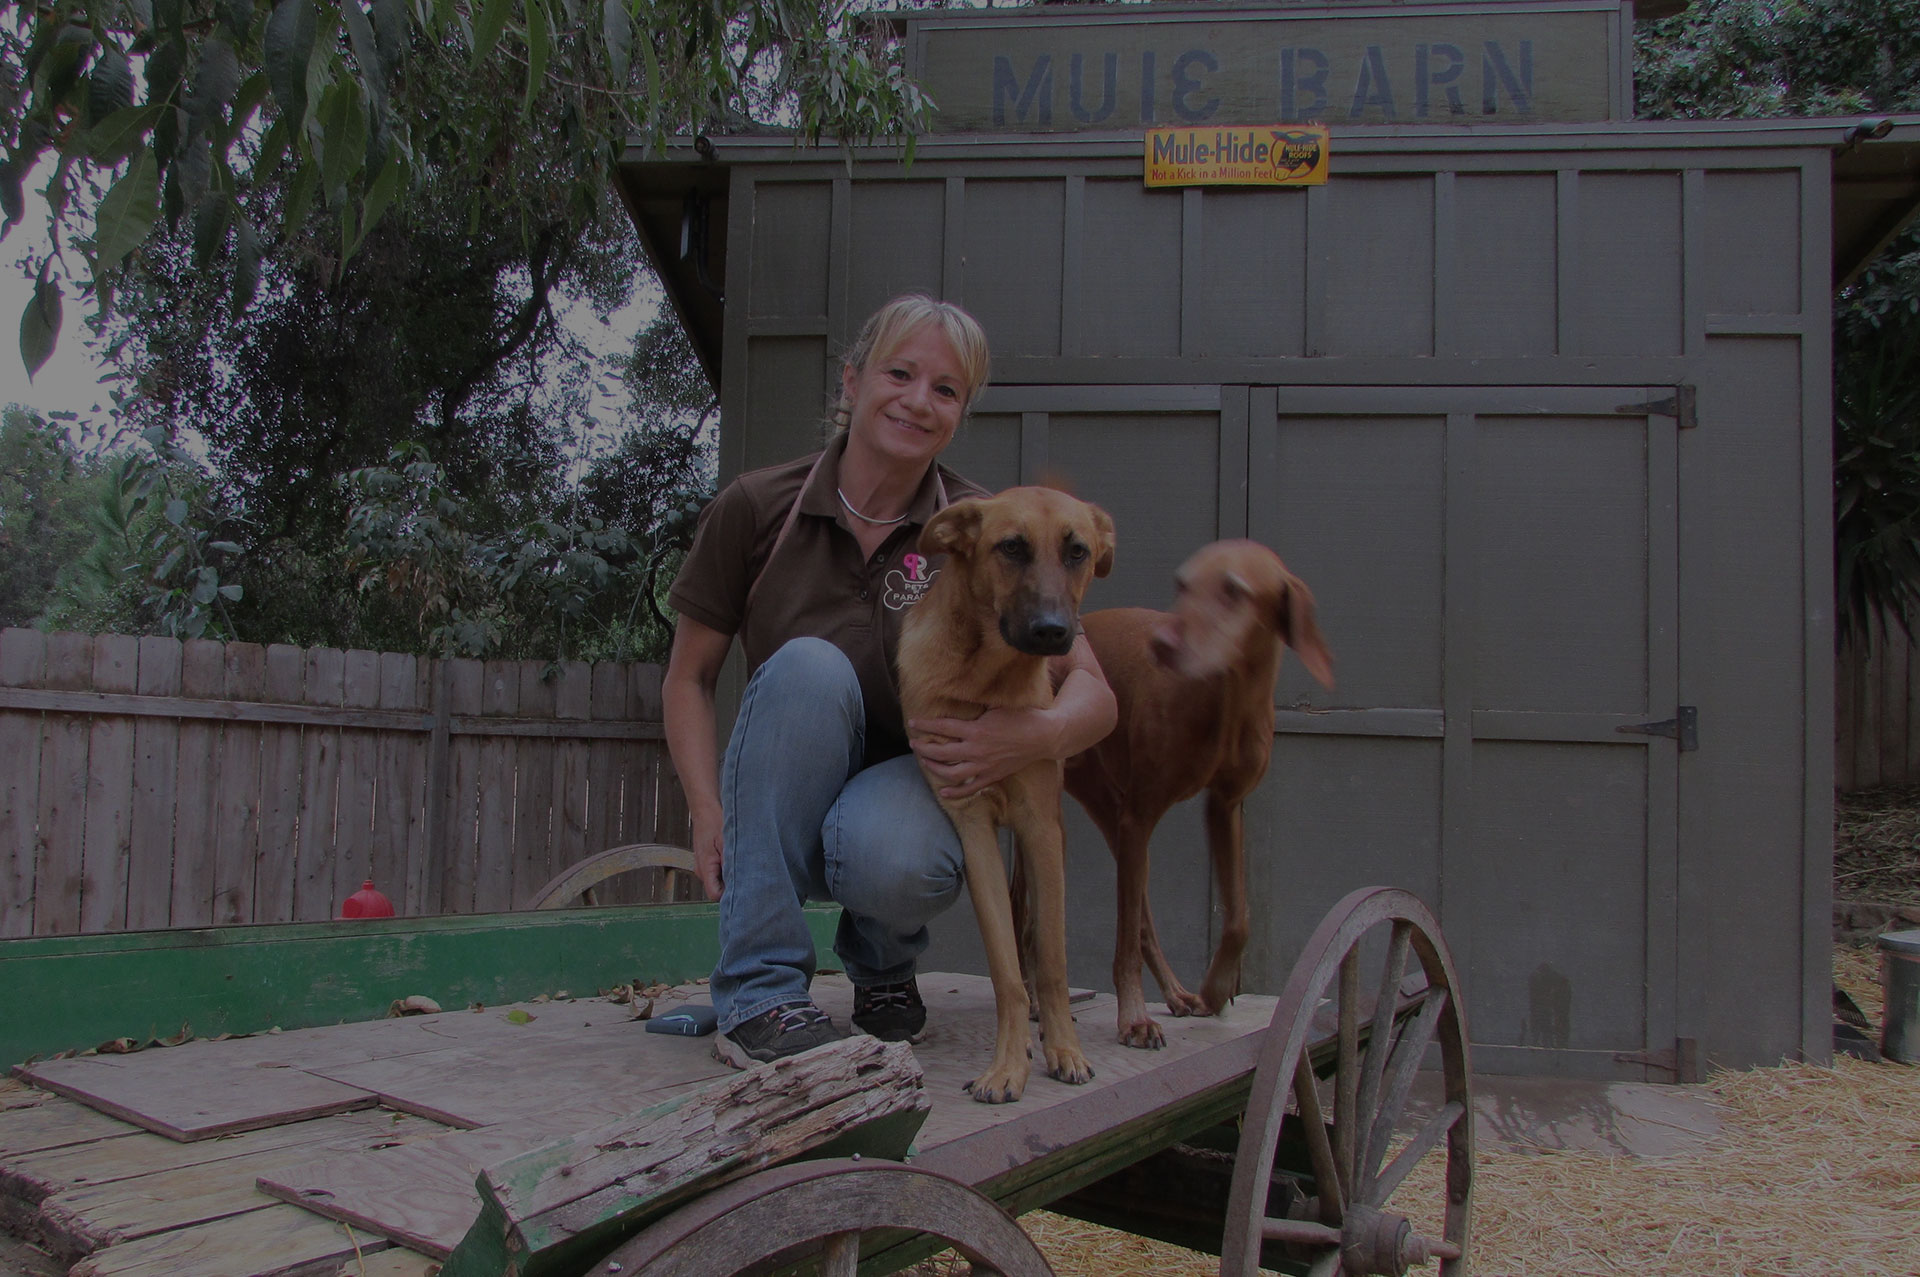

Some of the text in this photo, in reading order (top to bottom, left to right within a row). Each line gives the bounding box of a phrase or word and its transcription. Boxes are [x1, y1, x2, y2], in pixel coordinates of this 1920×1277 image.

[1280, 40, 1534, 120] BARN
[1153, 132, 1268, 165] Mule-Hide
[1152, 166, 1273, 181] Not a Kick in a Million Feet
